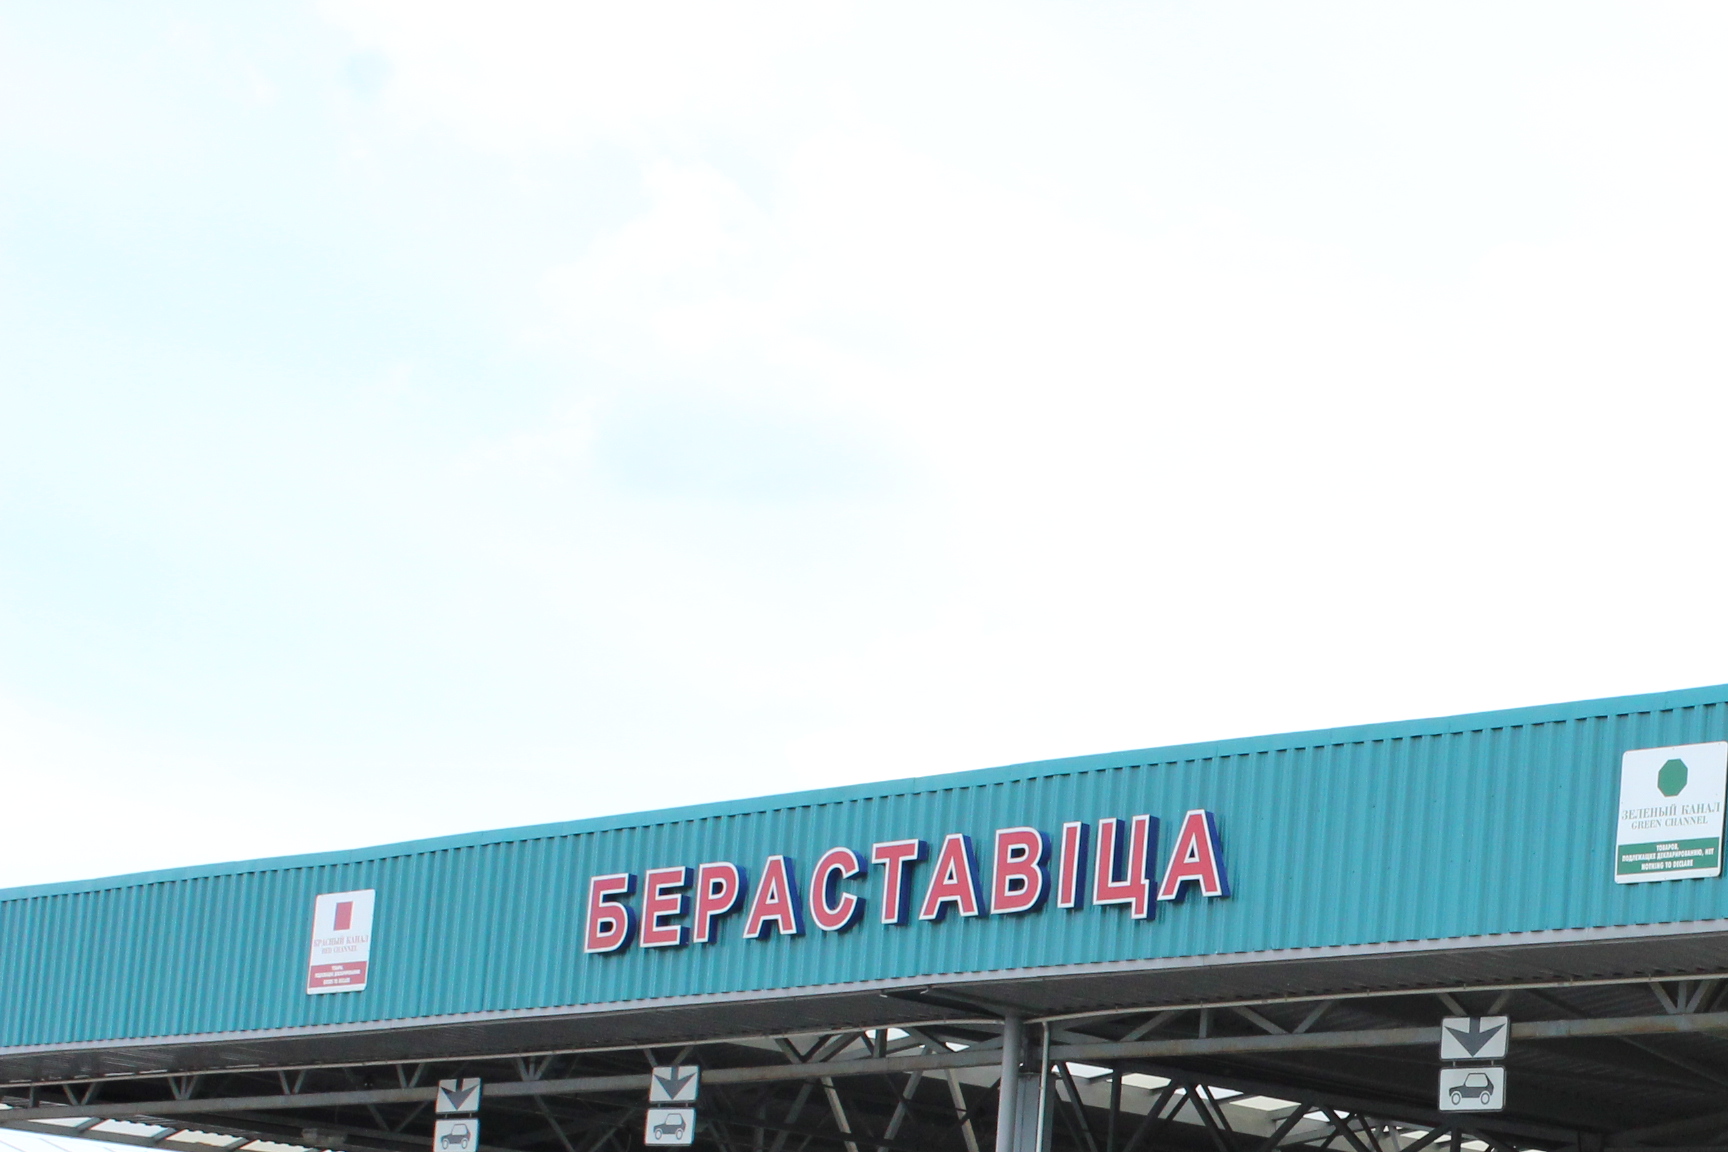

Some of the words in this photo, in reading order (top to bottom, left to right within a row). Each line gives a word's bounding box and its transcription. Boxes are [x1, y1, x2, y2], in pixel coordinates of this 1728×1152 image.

[1621, 803, 1677, 820] ЗЕЛЕНЫЙ
[1681, 801, 1721, 815] КАНАЛ
[1631, 819, 1662, 830] GREEN
[1664, 815, 1708, 827] CHANNEL
[583, 809, 1224, 955] БЕРАСТАВІЦА
